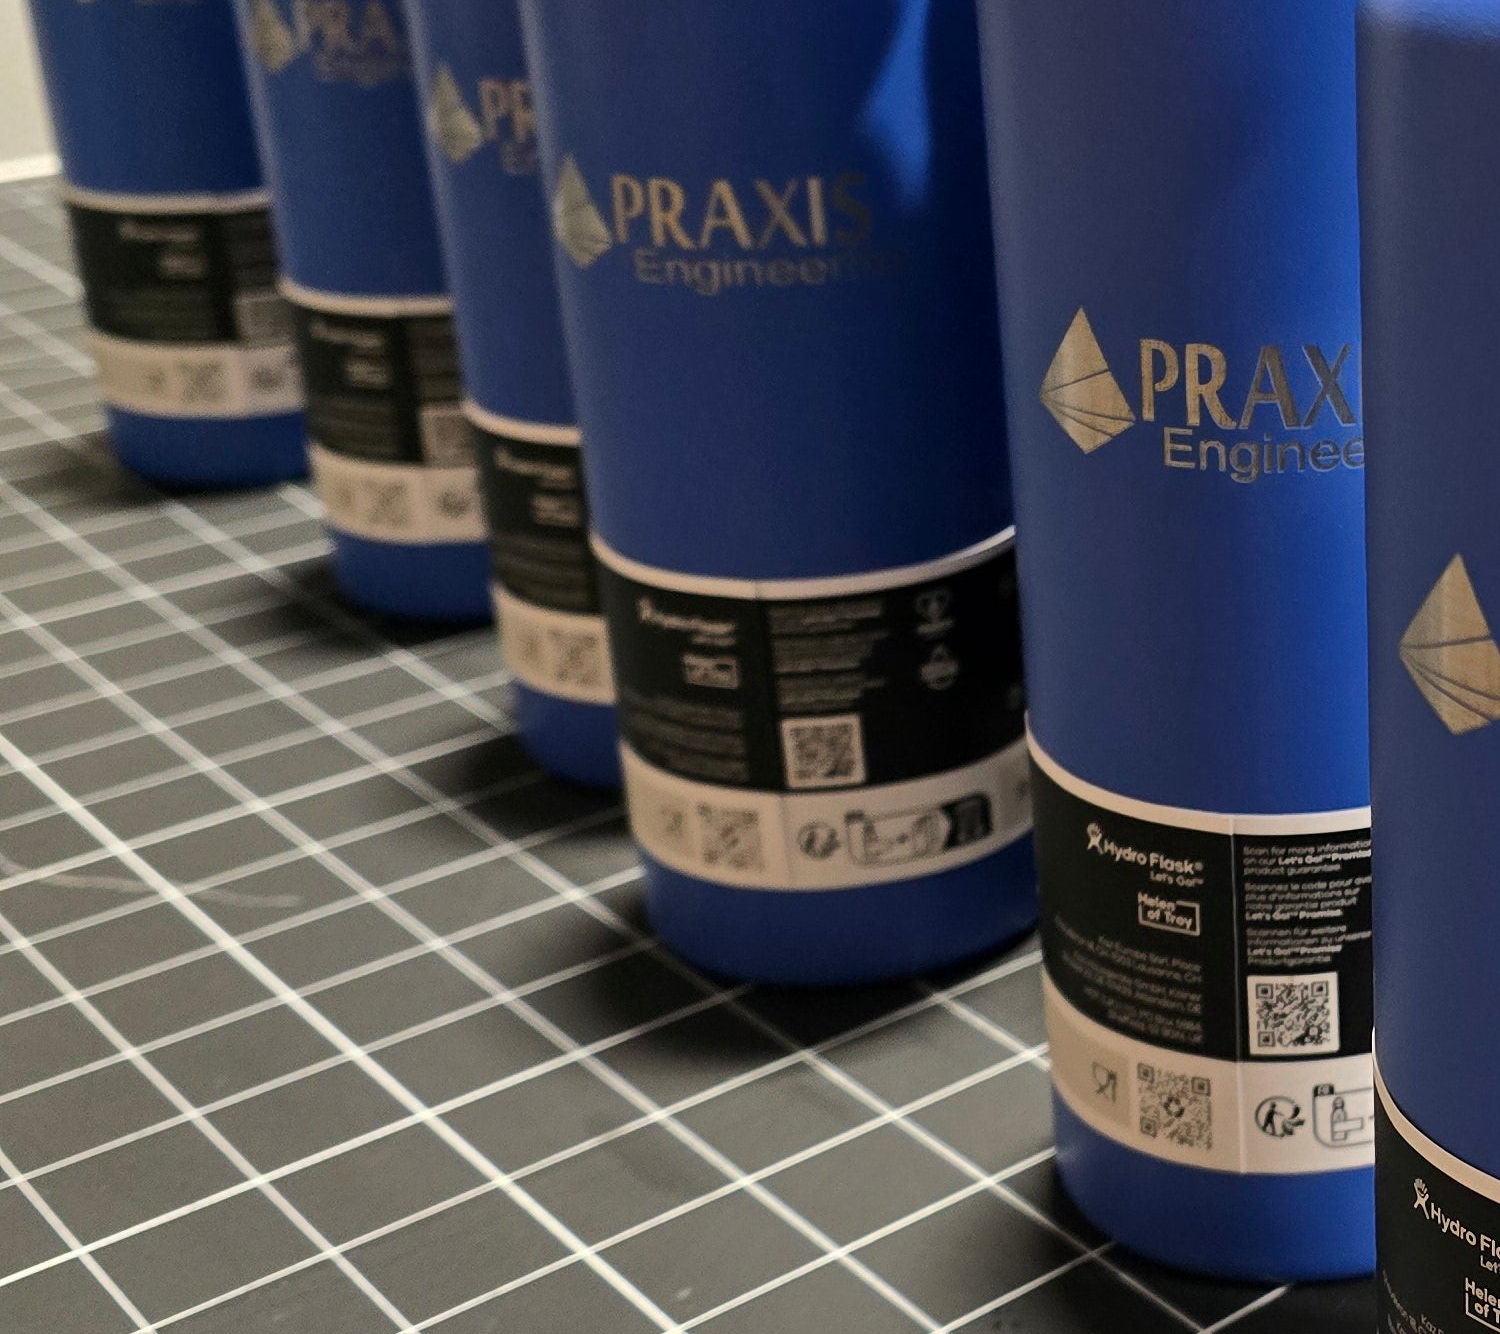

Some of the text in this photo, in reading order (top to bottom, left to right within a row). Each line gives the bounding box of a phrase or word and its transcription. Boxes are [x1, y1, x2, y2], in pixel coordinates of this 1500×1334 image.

[610, 173, 872, 251] PRAXIS
[1104, 839, 1147, 865] Hydro
[1430, 1202, 1477, 1246] Hydro
[1474, 1301, 1489, 1318] of
